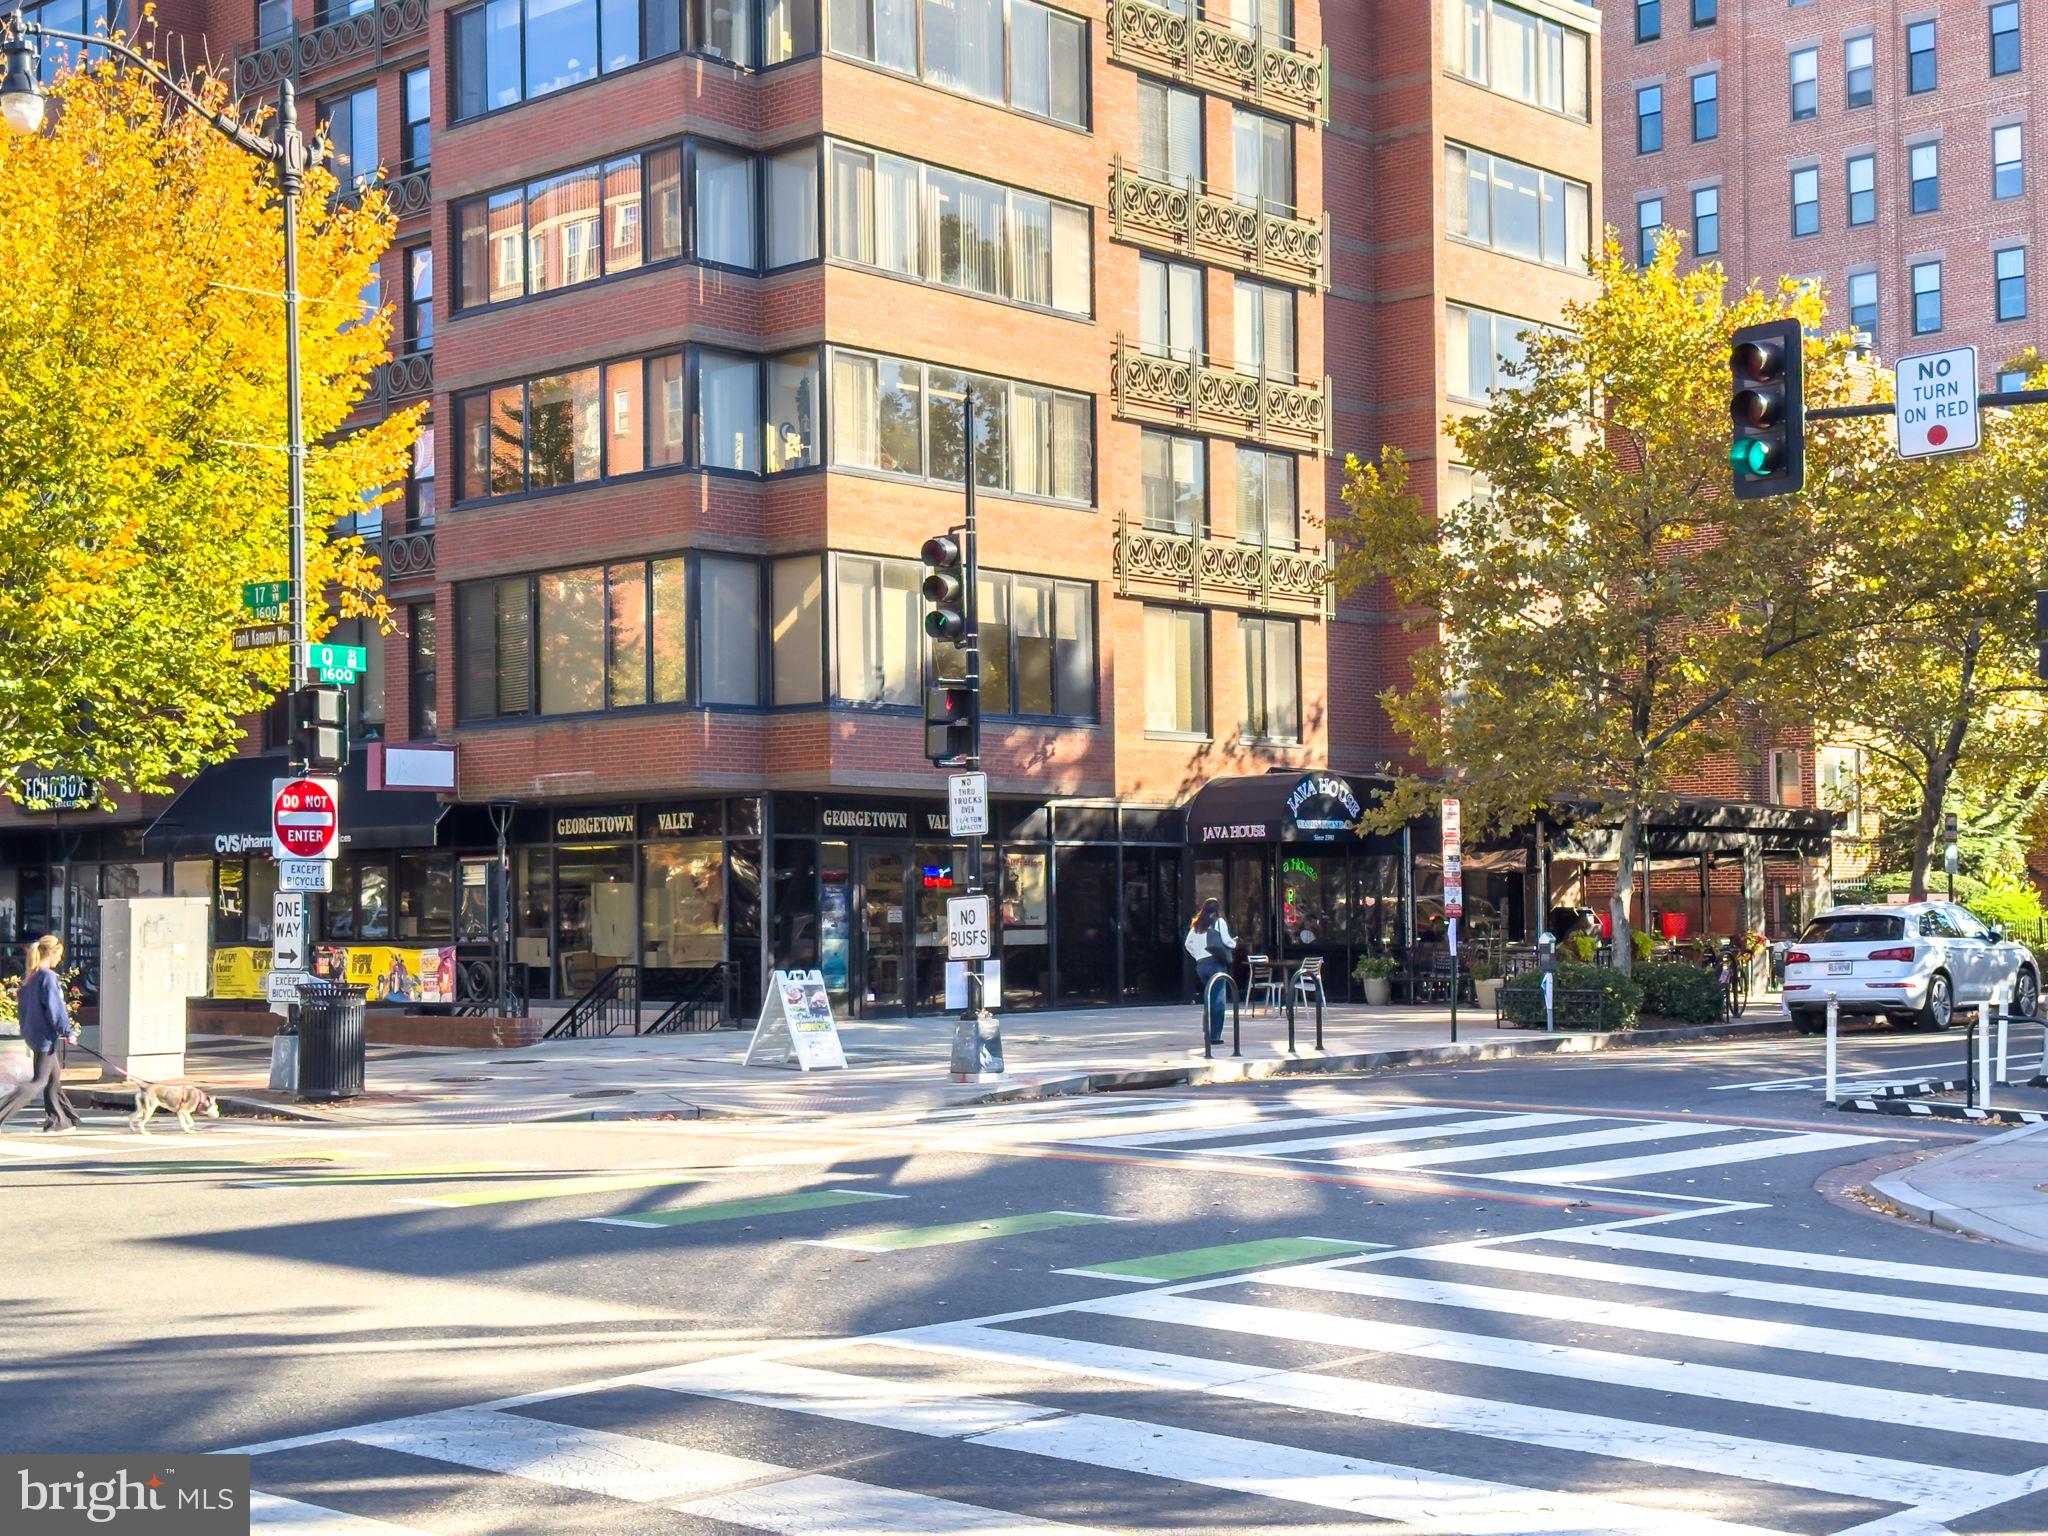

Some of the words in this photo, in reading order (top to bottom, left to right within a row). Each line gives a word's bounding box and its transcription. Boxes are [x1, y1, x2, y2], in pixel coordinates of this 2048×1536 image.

[1918, 358, 1951, 380] NO
[1913, 380, 1958, 402] TURN
[1904, 407, 1926, 424] ON
[1936, 400, 1968, 419] RED
[255, 587, 266, 604] 17
[255, 606, 278, 618] 1600
[232, 632, 250, 649] Frank
[251, 629, 276, 646] Kameny
[277, 625, 290, 643] Way
[321, 648, 334, 667] Q
[323, 668, 353, 681] 1600
[60, 774, 85, 798] BOX
[961, 778, 972, 786] NO
[959, 788, 976, 796] THRU
[1287, 780, 1318, 818] JAVA
[1318, 777, 1361, 819] HOUSE
[282, 794, 299, 808] DO
[306, 795, 328, 808] NOT
[954, 796, 983, 805] TRUCKS
[557, 815, 634, 836] GEORGETOWN
[658, 812, 695, 831] VALET
[823, 810, 907, 828] GEORGETOWN
[927, 814, 949, 830] VAL
[288, 829, 323, 843] ENTER
[1203, 826, 1229, 842] JAVA
[1230, 824, 1266, 838] HOUSE
[215, 833, 273, 853] CVS/pharm
[291, 864, 322, 875] EXCEPT
[286, 877, 326, 887] BICYCLES
[276, 902, 300, 917] ONE
[960, 909, 976, 925] NO
[276, 922, 301, 938] WAY
[275, 977, 300, 986] EXCEPT
[272, 989, 299, 998] BICYCLE
